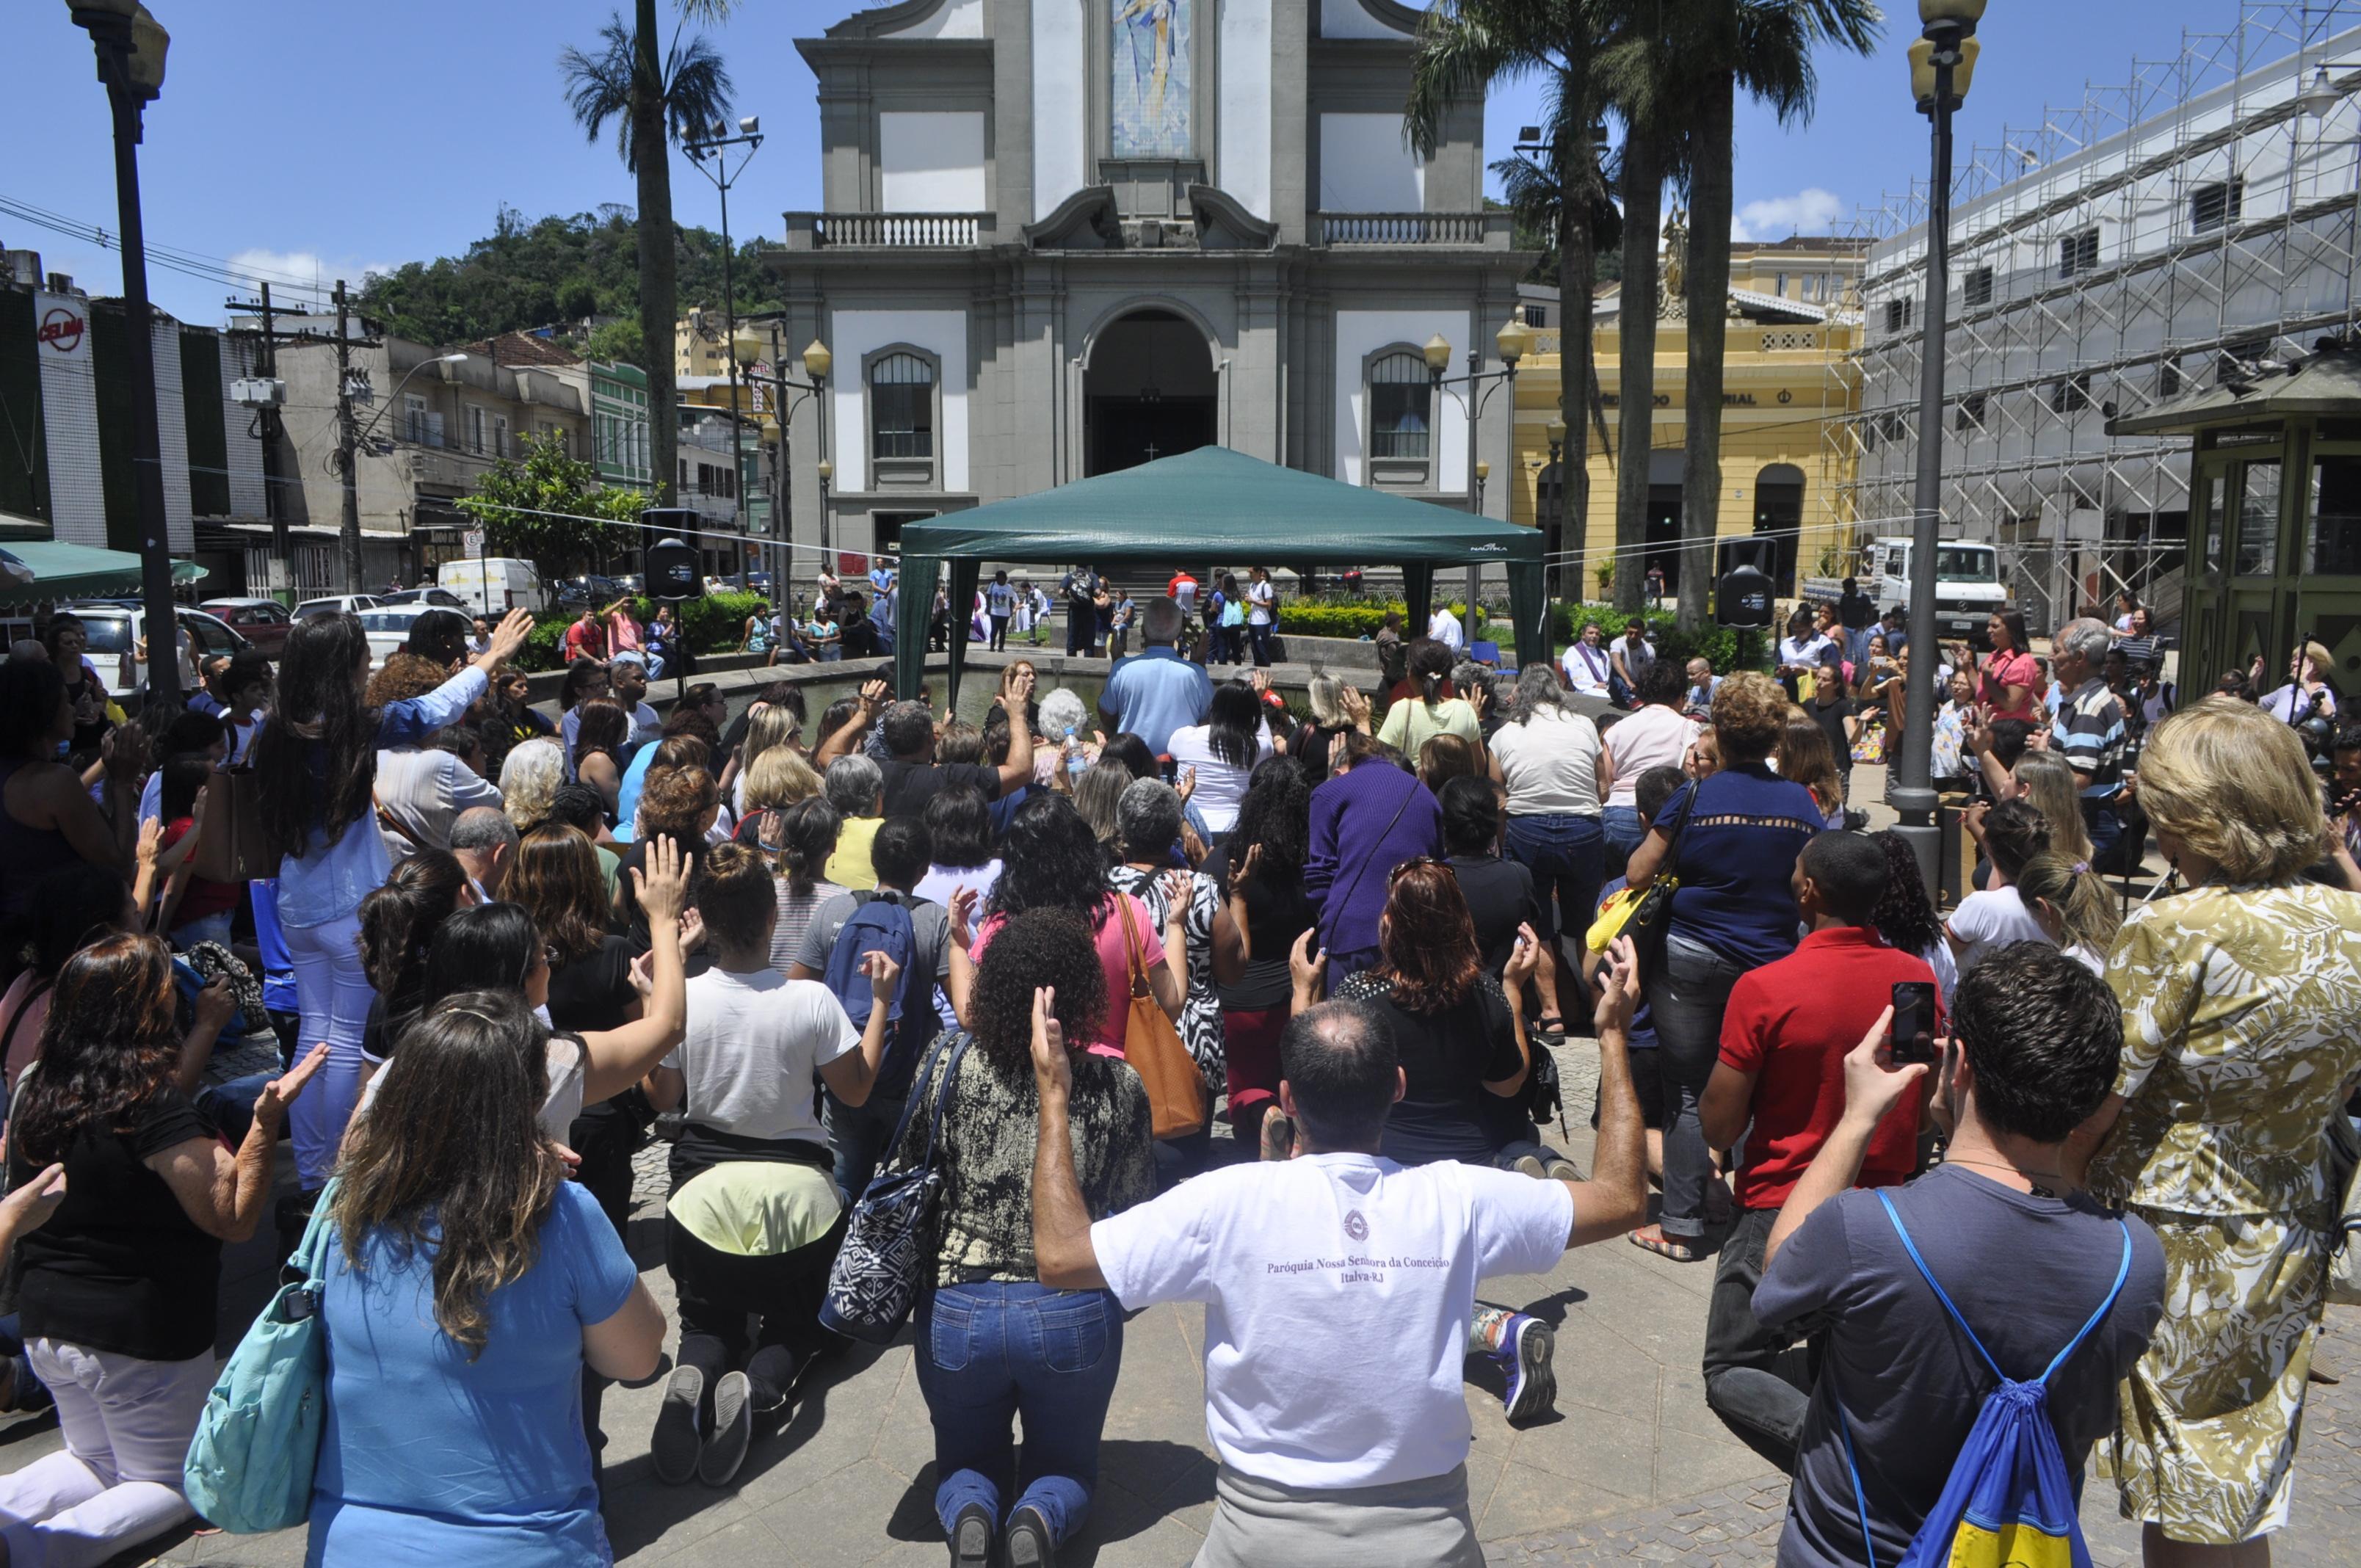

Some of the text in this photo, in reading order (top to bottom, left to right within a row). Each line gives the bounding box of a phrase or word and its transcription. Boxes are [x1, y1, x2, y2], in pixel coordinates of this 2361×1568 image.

[38, 317, 84, 343] CELMA
[750, 364, 769, 373] OTEL
[1267, 1254, 1450, 1274] Paróquia Nossa Senhora da Conceição
[1341, 1270, 1385, 1283] Italva-RJ
